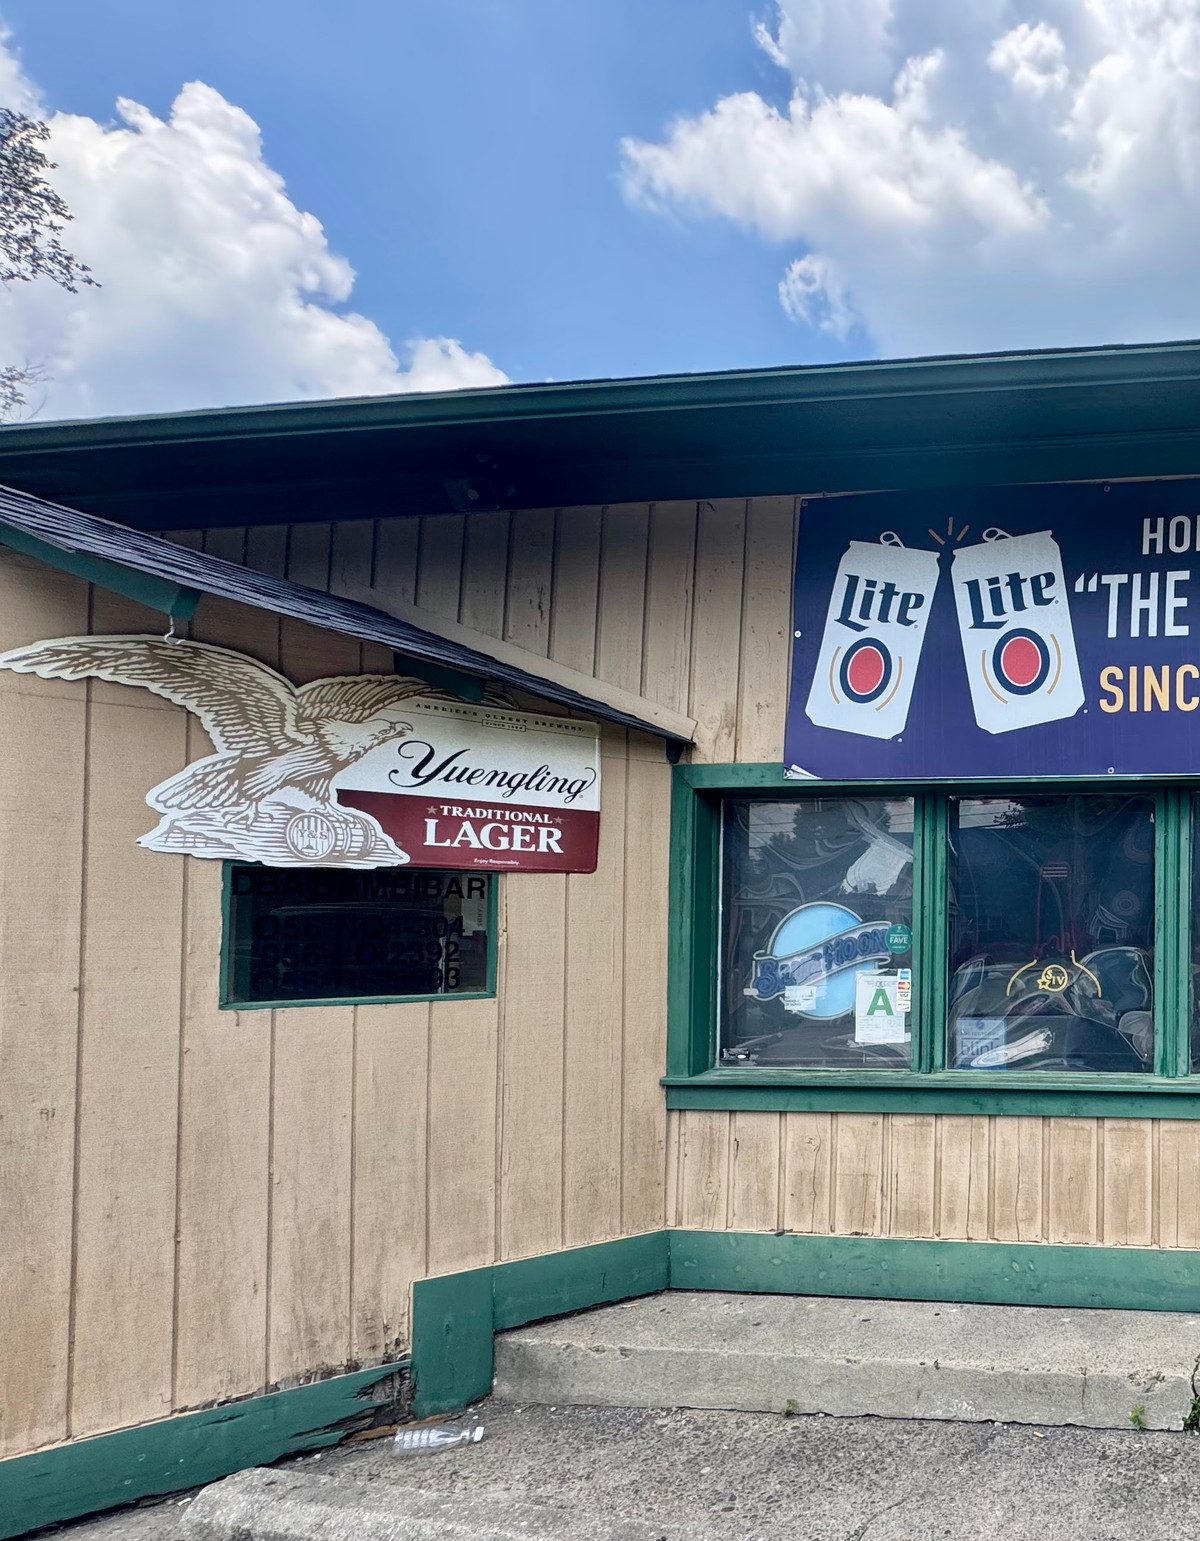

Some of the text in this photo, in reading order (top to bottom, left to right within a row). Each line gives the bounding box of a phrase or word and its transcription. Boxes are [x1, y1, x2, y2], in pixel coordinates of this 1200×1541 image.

[833, 573, 926, 632] Lite
[962, 569, 1056, 632] Lite
[388, 740, 597, 804] Yuengling
[440, 805, 553, 824] TRADITIONAL
[298, 829, 328, 840] Y&S
[423, 818, 564, 854] LAGER
[889, 936, 908, 944] FAVE
[866, 988, 894, 1016] A
